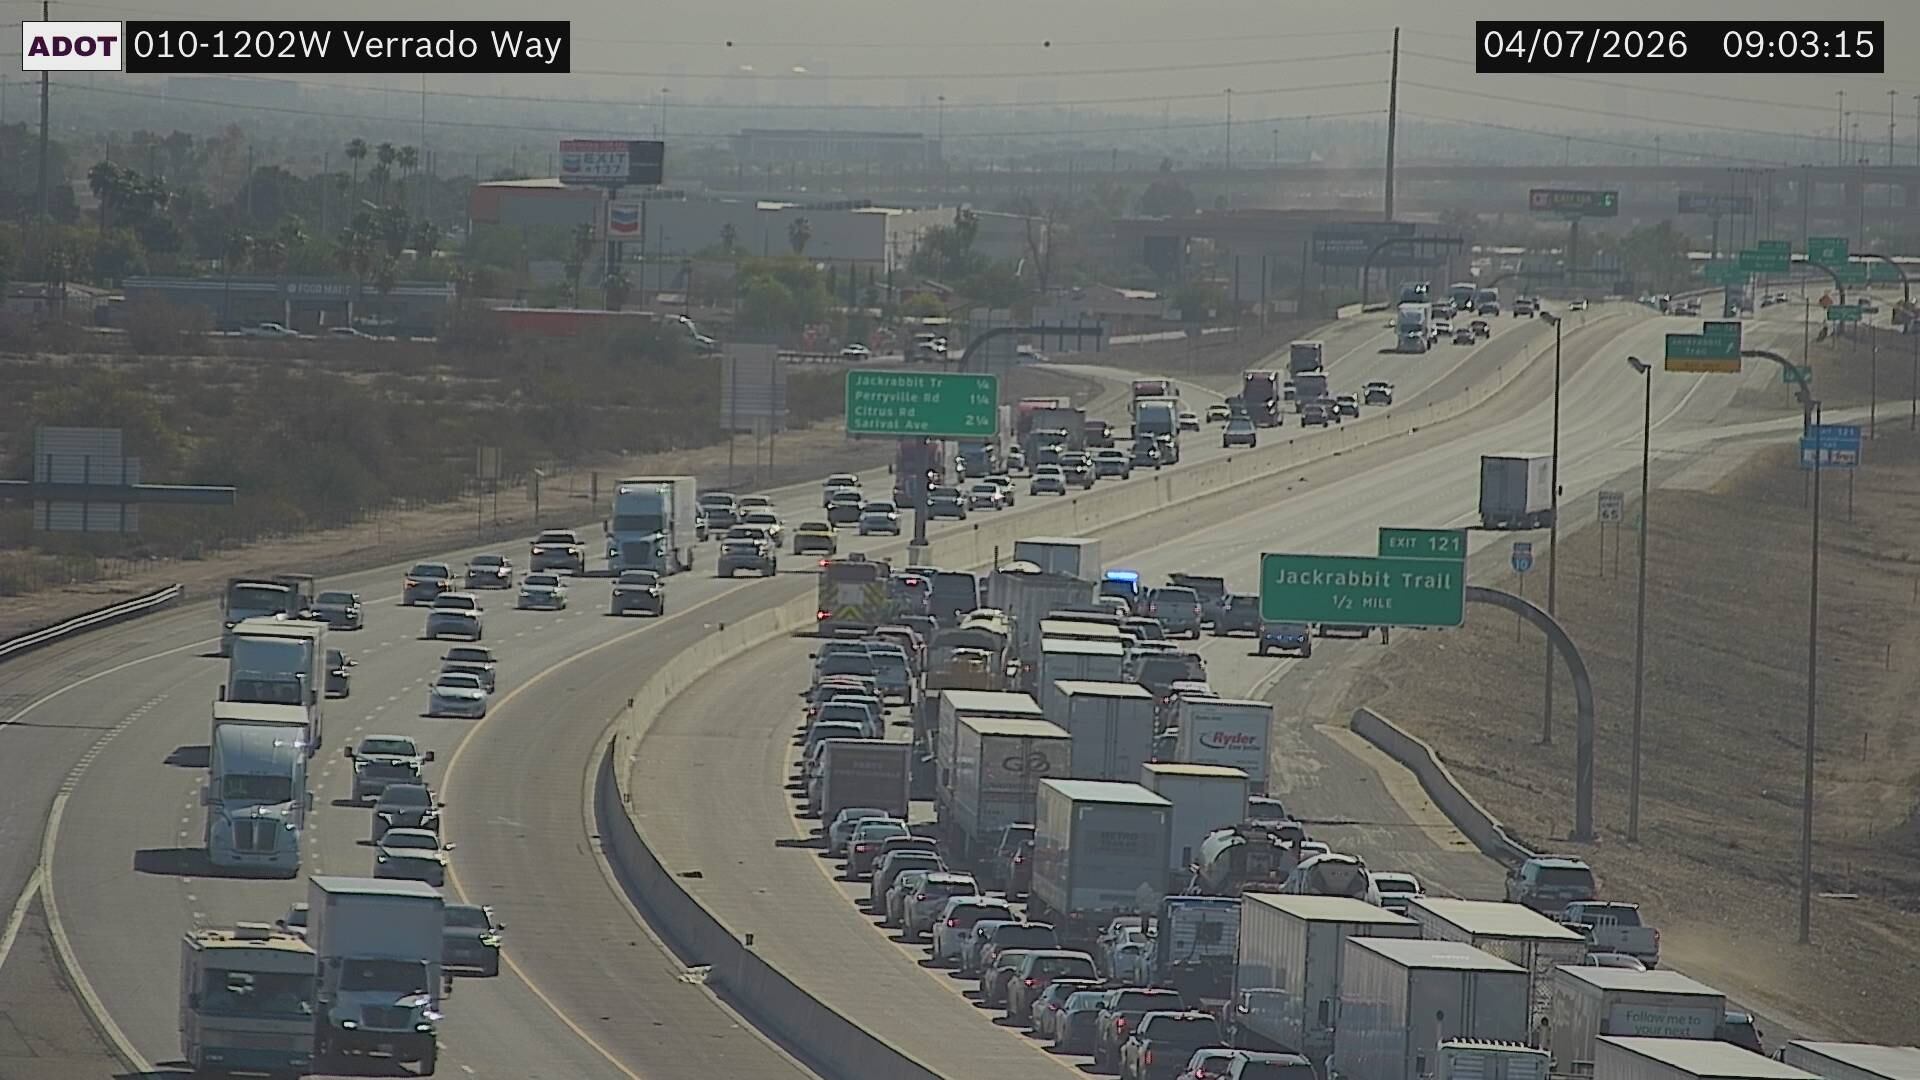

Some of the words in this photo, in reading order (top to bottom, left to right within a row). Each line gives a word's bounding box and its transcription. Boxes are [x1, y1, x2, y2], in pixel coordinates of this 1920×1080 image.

[855, 375, 924, 388] Jackrabbit
[930, 377, 943, 388] Tr
[855, 391, 918, 404] Perryville
[923, 392, 940, 403] Rd
[854, 406, 893, 417] Citrus
[899, 407, 916, 417] Rd
[904, 420, 929, 430] Ave
[1389, 537, 1417, 548] EXIT
[1429, 537, 1460, 552] 121
[1276, 569, 1391, 588] Jackrabbit
[1402, 572, 1451, 590] Trail
[1362, 598, 1393, 609] MILE
[1213, 731, 1256, 745] Ryder
[1626, 1010, 1666, 1023] Follow
[1667, 1015, 1685, 1025] me
[1688, 1014, 1701, 1025] to
[1635, 1026, 1661, 1035] your
[1665, 1026, 1690, 1035] next
